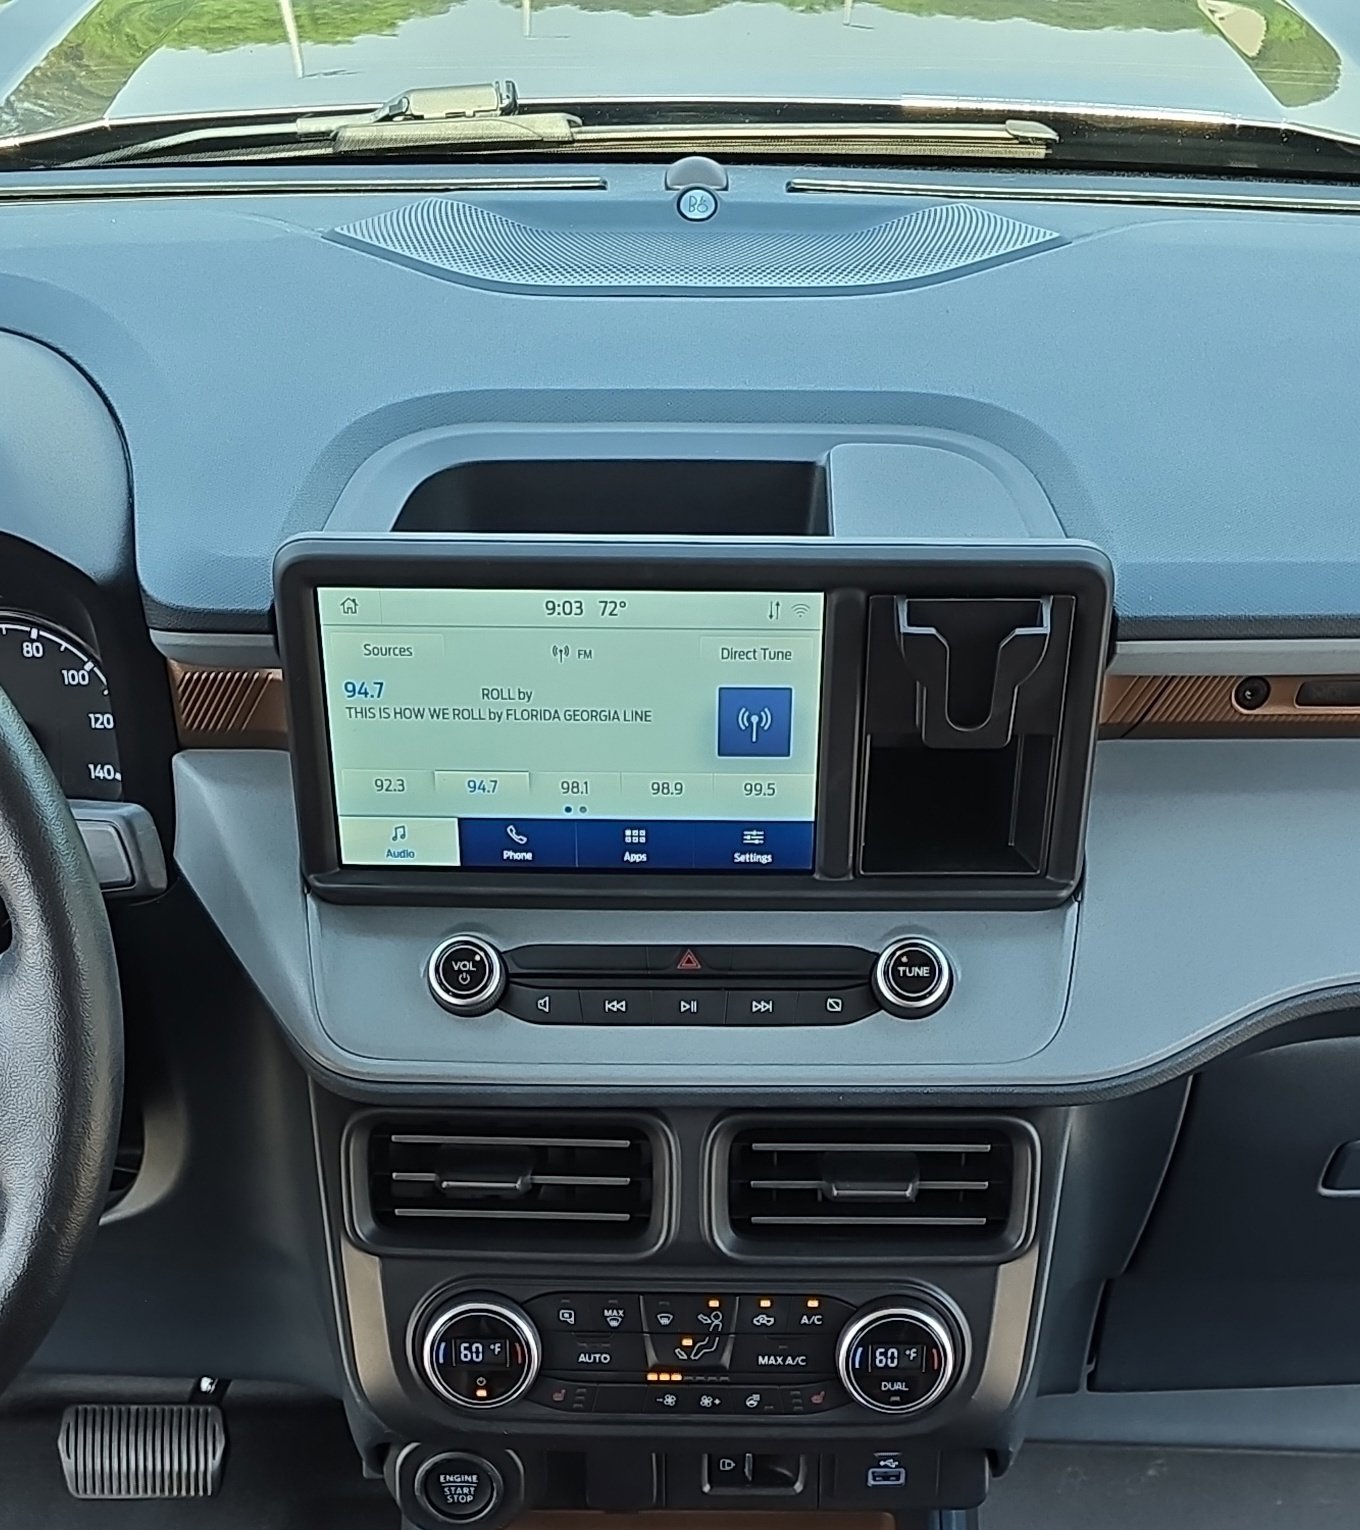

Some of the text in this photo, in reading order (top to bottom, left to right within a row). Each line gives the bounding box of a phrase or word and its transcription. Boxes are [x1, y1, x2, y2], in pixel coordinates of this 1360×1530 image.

[545, 600, 627, 617] 9:03 72°
[22, 641, 44, 658] 80
[362, 643, 413, 657] Sources
[577, 649, 593, 660] FM
[721, 647, 792, 662] Direct Tune
[61, 669, 89, 686] 100
[343, 681, 384, 699] 94.7
[481, 687, 533, 704] ROLL by
[345, 706, 652, 723] THIS IS HOW WE ROLL by FLORIDA GEORGIA LINE
[88, 713, 115, 730] 120
[88, 764, 115, 780] 140
[373, 778, 776, 797] 92.3 94.7 98.1 98.9 99.5
[385, 848, 415, 860] Audio
[503, 850, 533, 861] Phone
[623, 851, 647, 864] Apps
[733, 852, 773, 865] Settings
[451, 960, 477, 972] VOL
[897, 966, 931, 977] TUNE
[603, 1308, 625, 1318] MAX
[800, 1314, 824, 1326] A/C
[459, 1342, 484, 1363] 60
[577, 1352, 611, 1364] AUTO
[875, 1347, 899, 1368] 60
[757, 1355, 807, 1367] MAX A/C
[881, 1381, 909, 1392] DUAL
[439, 1474, 479, 1483] ENGINE
[443, 1486, 476, 1495] START
[446, 1494, 474, 1504] STOP
